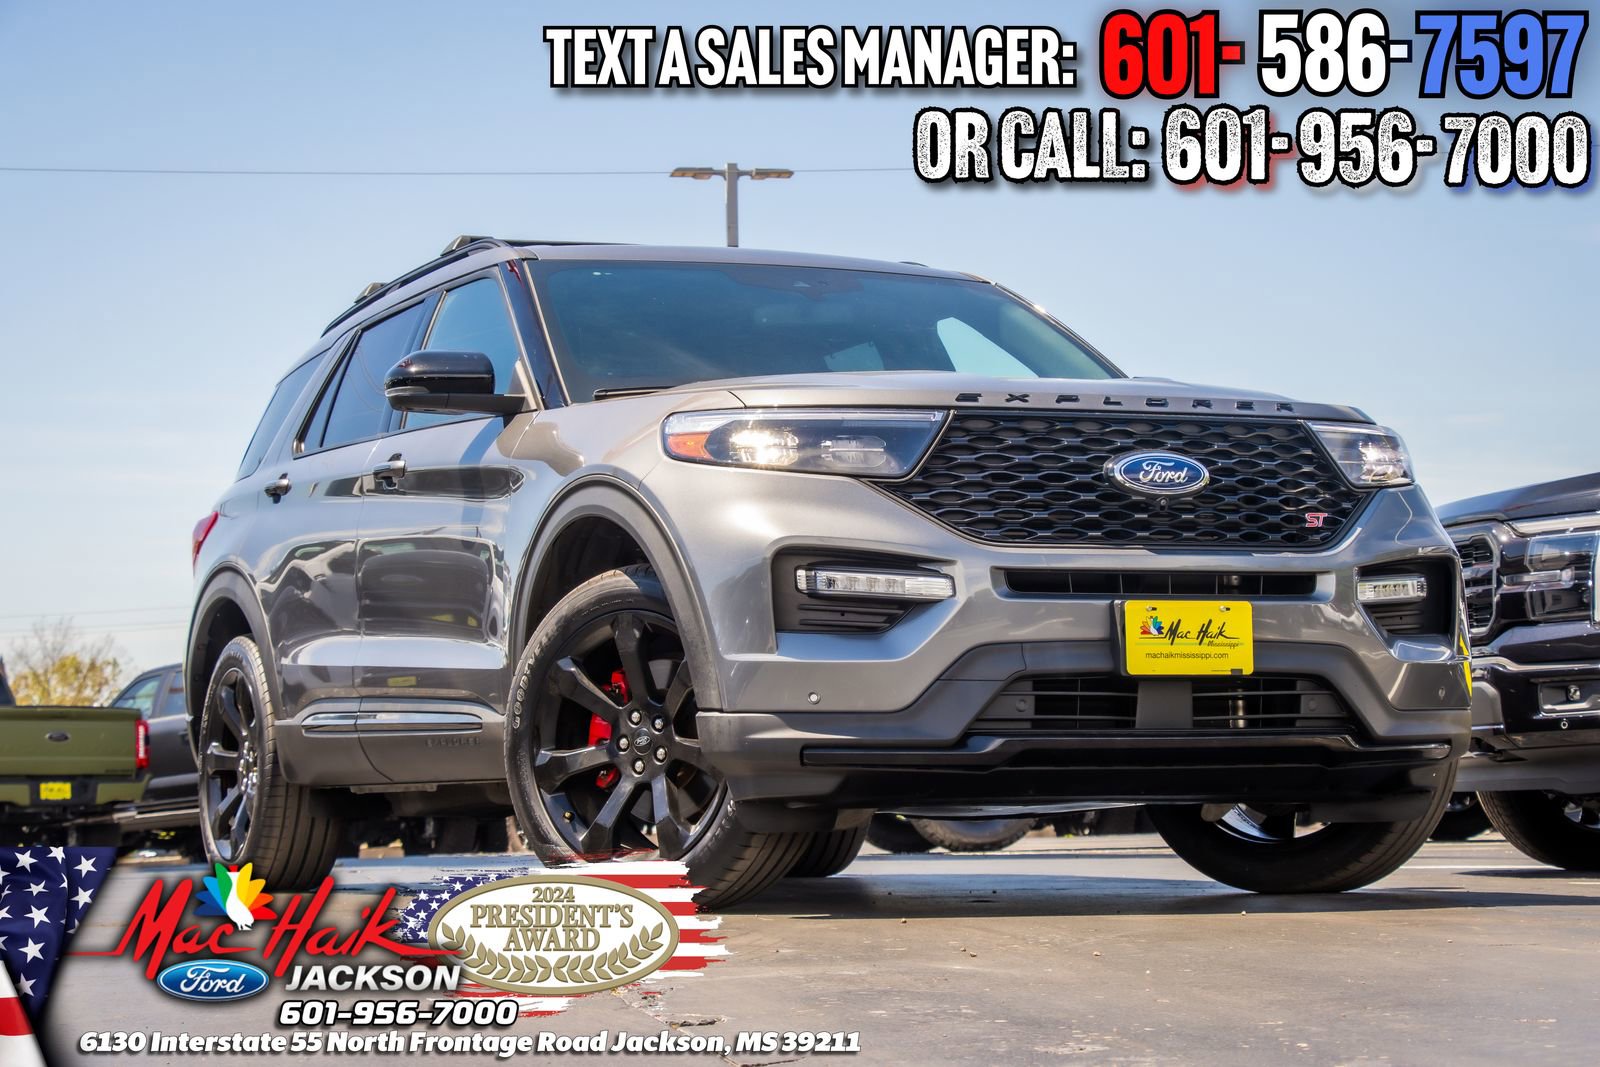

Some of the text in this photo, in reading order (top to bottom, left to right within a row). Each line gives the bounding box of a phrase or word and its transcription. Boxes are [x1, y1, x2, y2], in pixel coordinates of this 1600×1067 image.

[955, 393, 1294, 412] EXPLORER
[1139, 460, 1189, 483] Ford
[1305, 512, 1328, 527] ST
[1151, 619, 1236, 646] Mac Haik
[1145, 651, 1229, 660] machaikmississippi.com
